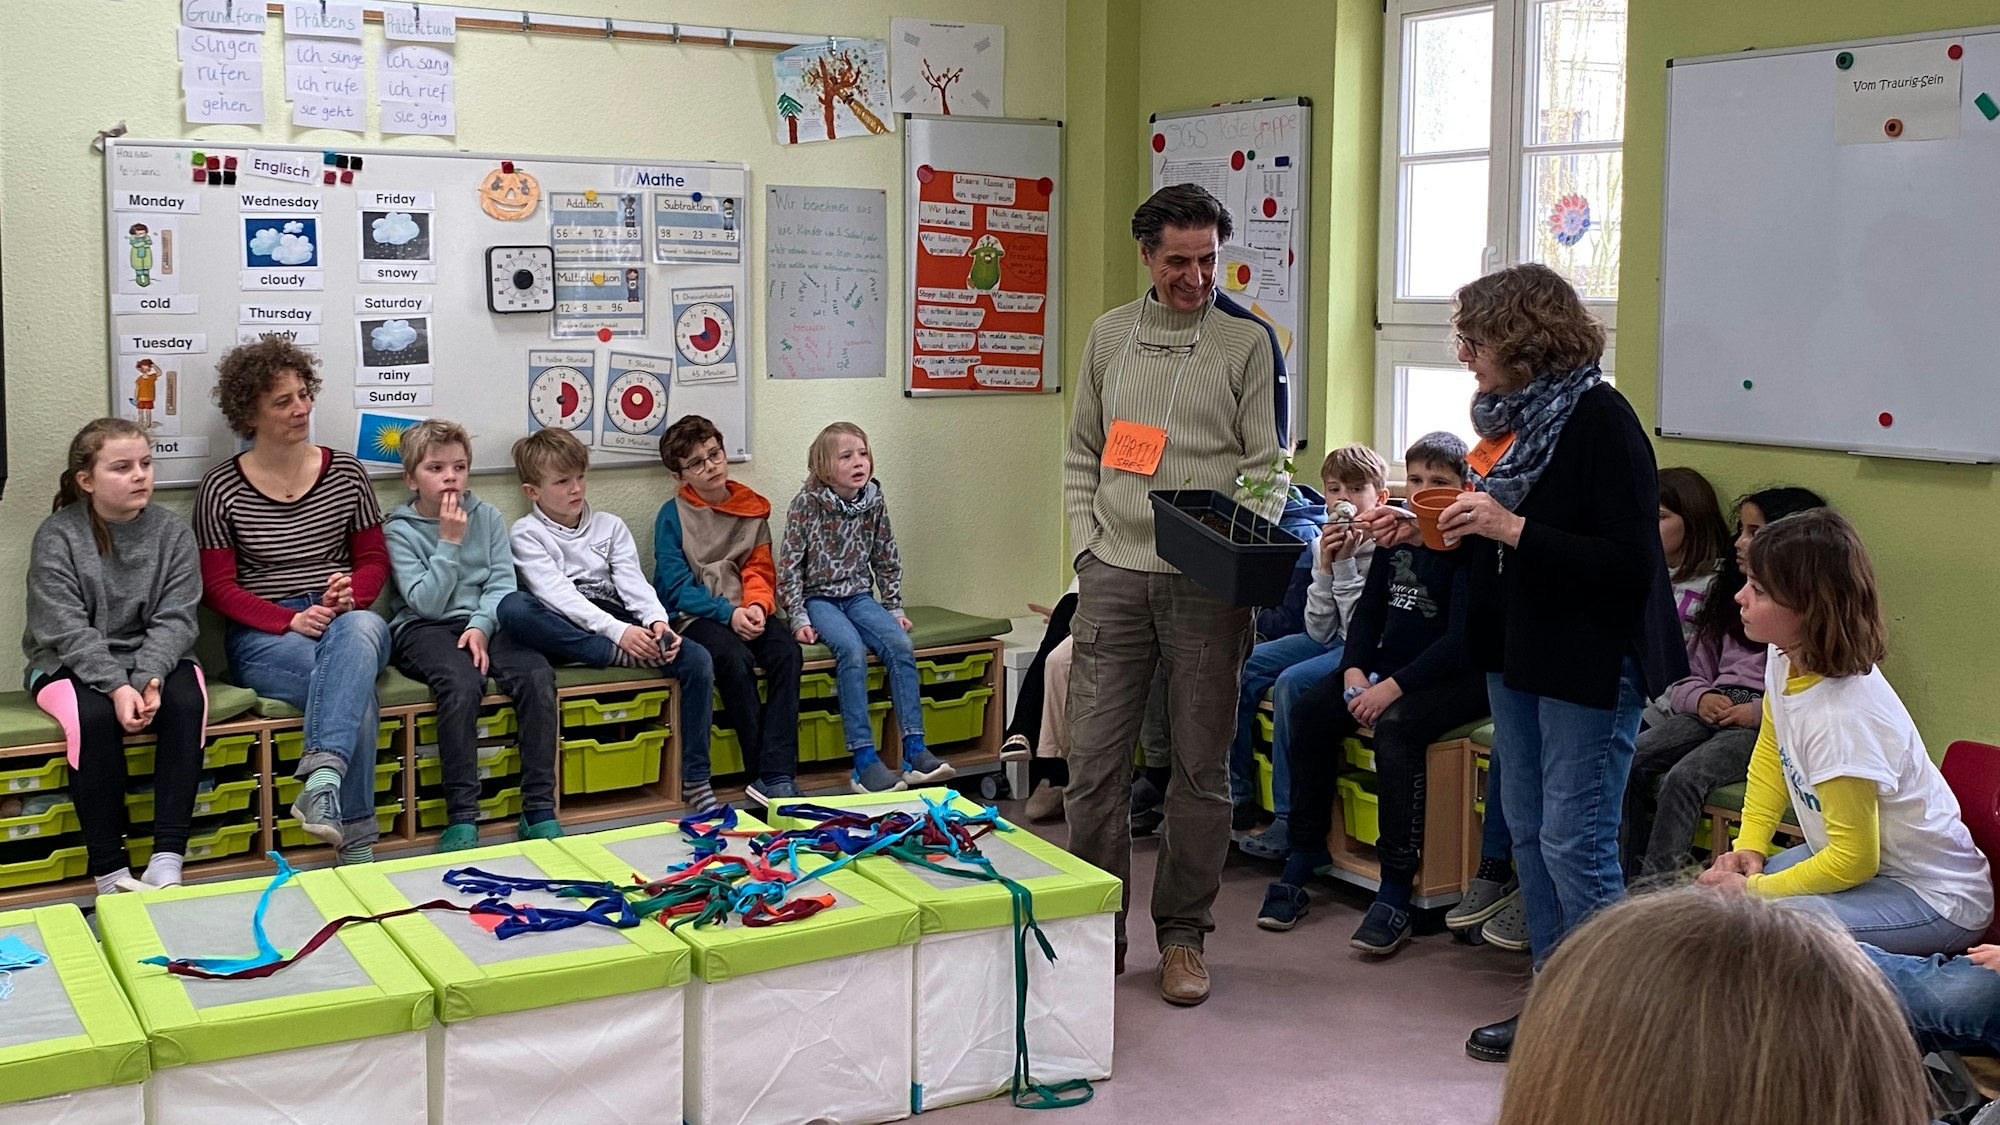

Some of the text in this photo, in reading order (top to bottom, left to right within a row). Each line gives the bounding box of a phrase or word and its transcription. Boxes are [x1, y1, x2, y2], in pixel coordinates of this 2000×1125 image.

[297, 45, 365, 69] ich singe
[387, 52, 449, 76] ich sang
[198, 64, 250, 85] rufen
[298, 76, 359, 94] ich rufe
[1853, 74, 1944, 92] Vom Traurig-Sein
[389, 81, 448, 102] ich rief
[201, 97, 252, 116] gehen
[300, 105, 354, 120] sie geht
[394, 111, 447, 128] sie ging
[254, 158, 309, 178] Englisch
[636, 172, 684, 187] Mathe
[129, 194, 184, 209] Monday
[242, 195, 319, 209] Wednesday
[376, 194, 415, 206] Friday
[566, 198, 604, 208] Addition
[664, 200, 713, 211] Subtraktion
[556, 229, 568, 238] 56
[593, 230, 603, 238] 12
[627, 230, 638, 238] 68
[660, 229, 671, 237] 98
[693, 231, 703, 239] 23
[726, 232, 735, 240] 75
[378, 268, 418, 280] snowy
[557, 272, 620, 285] Multiplition
[260, 274, 305, 288] cloudy
[141, 298, 170, 308] cold
[365, 298, 422, 310] Saturday
[560, 304, 570, 312] 12
[583, 304, 587, 312] 8
[612, 303, 622, 312] 96
[249, 308, 312, 321] Thursday
[133, 338, 192, 350] Tuesday
[379, 370, 410, 382] rainy
[370, 391, 417, 403] Sunday
